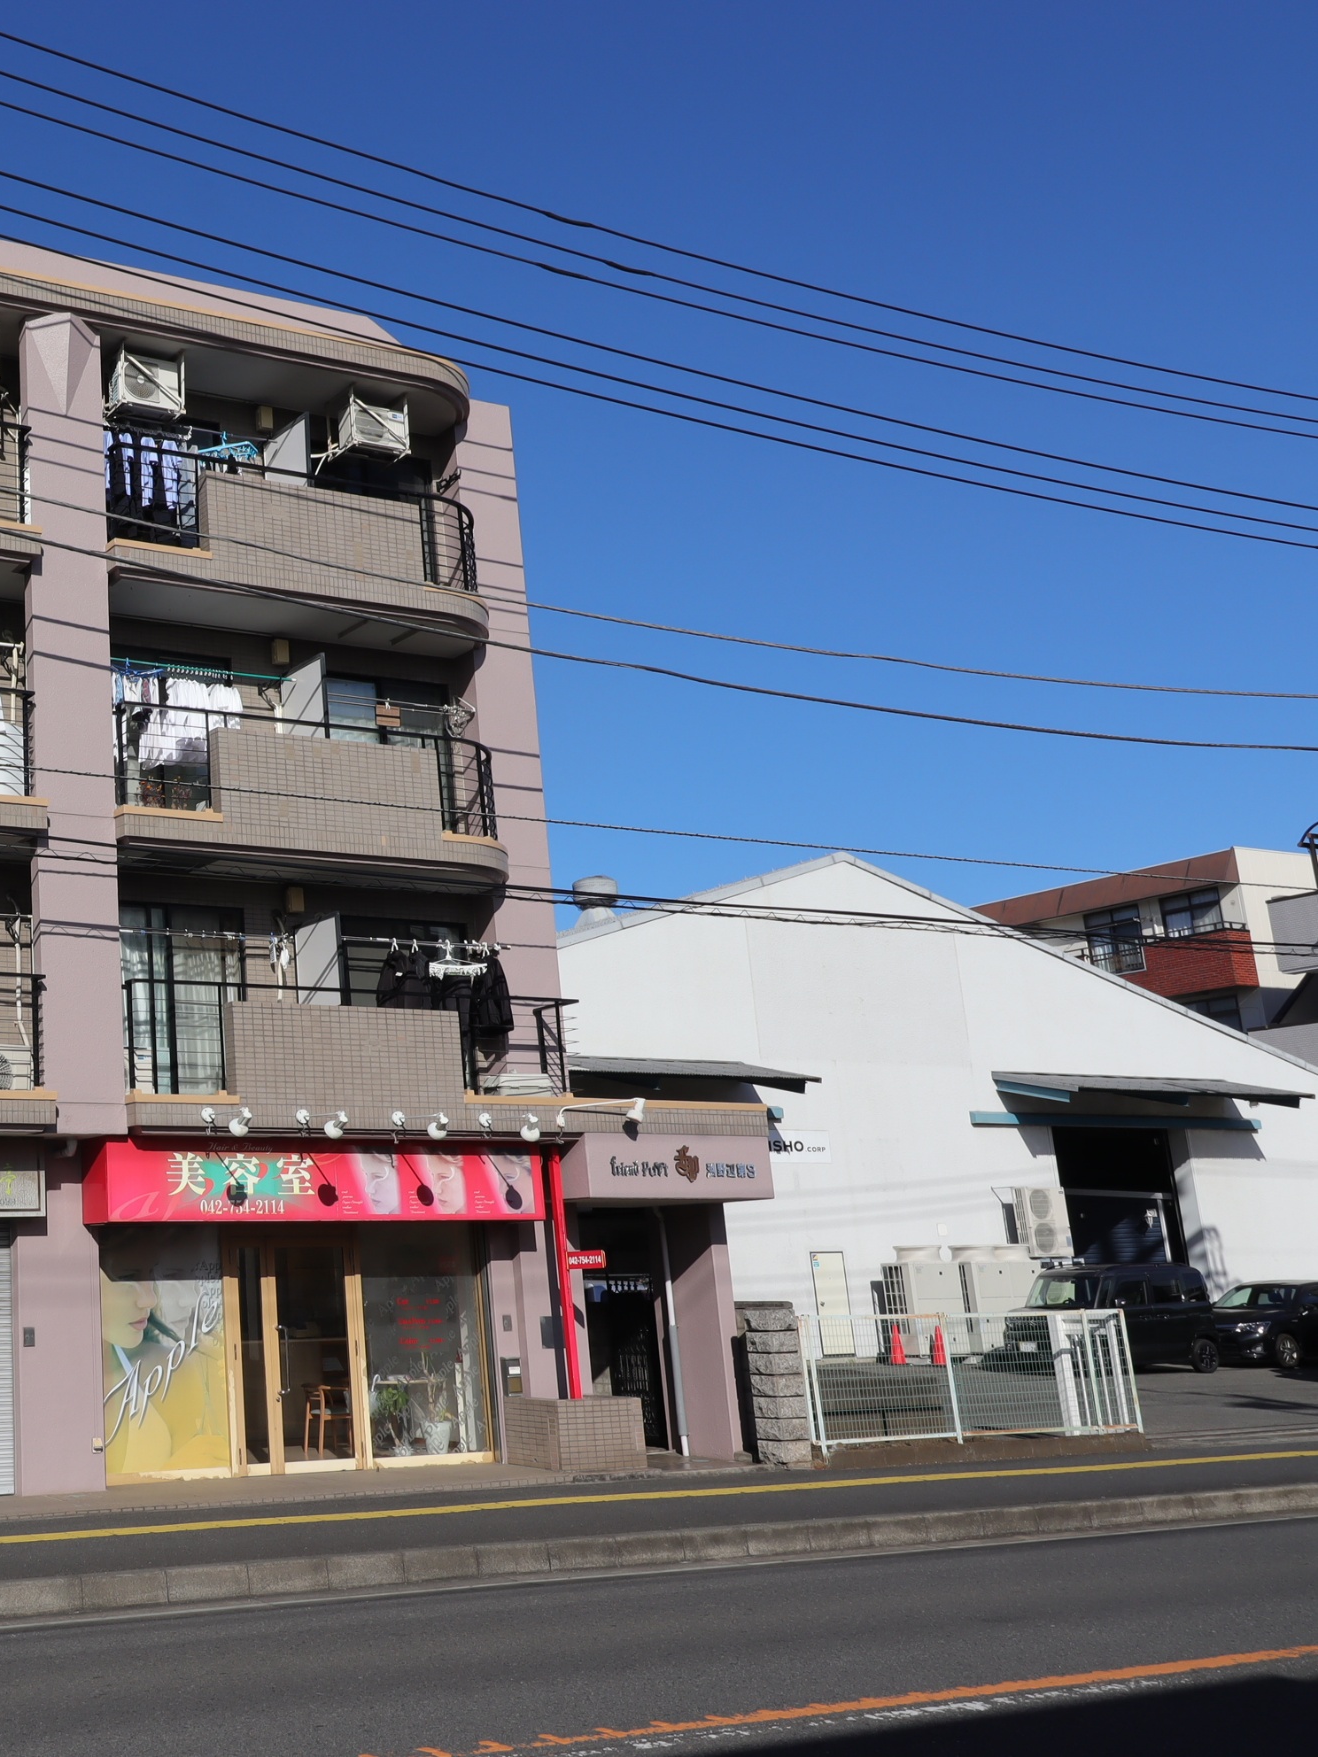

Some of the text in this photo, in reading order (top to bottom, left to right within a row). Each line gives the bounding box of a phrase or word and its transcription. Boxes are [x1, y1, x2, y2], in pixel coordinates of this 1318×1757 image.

[166, 1152, 316, 1197] 美容室
[103, 1290, 220, 1447] Apple
